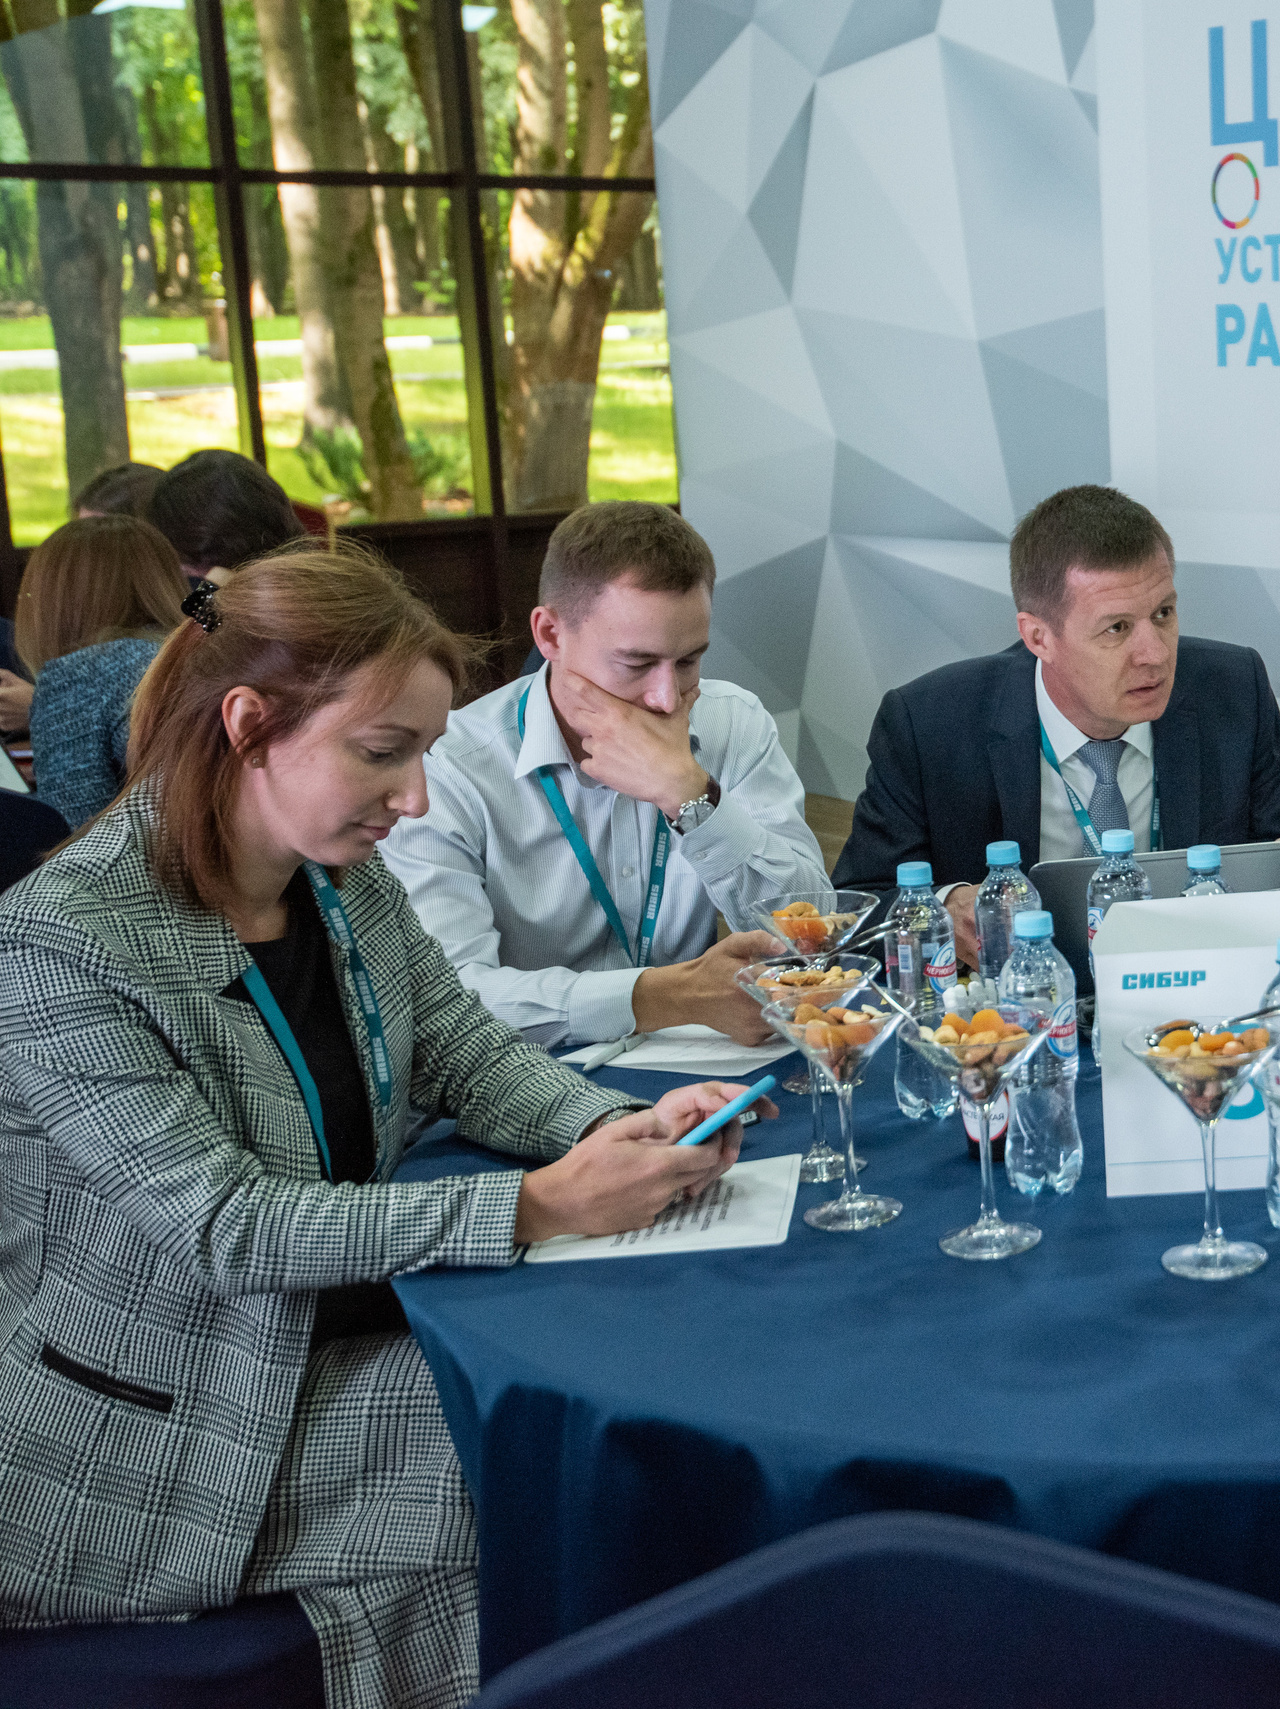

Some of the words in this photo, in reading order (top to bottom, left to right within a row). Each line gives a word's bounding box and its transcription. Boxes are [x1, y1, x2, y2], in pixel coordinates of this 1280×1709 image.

[655, 831, 667, 868] SIBUR
[646, 884, 660, 920] SIBUR
[1122, 970, 1206, 990] СИБУР
[372, 1037, 389, 1083] SIBUR
